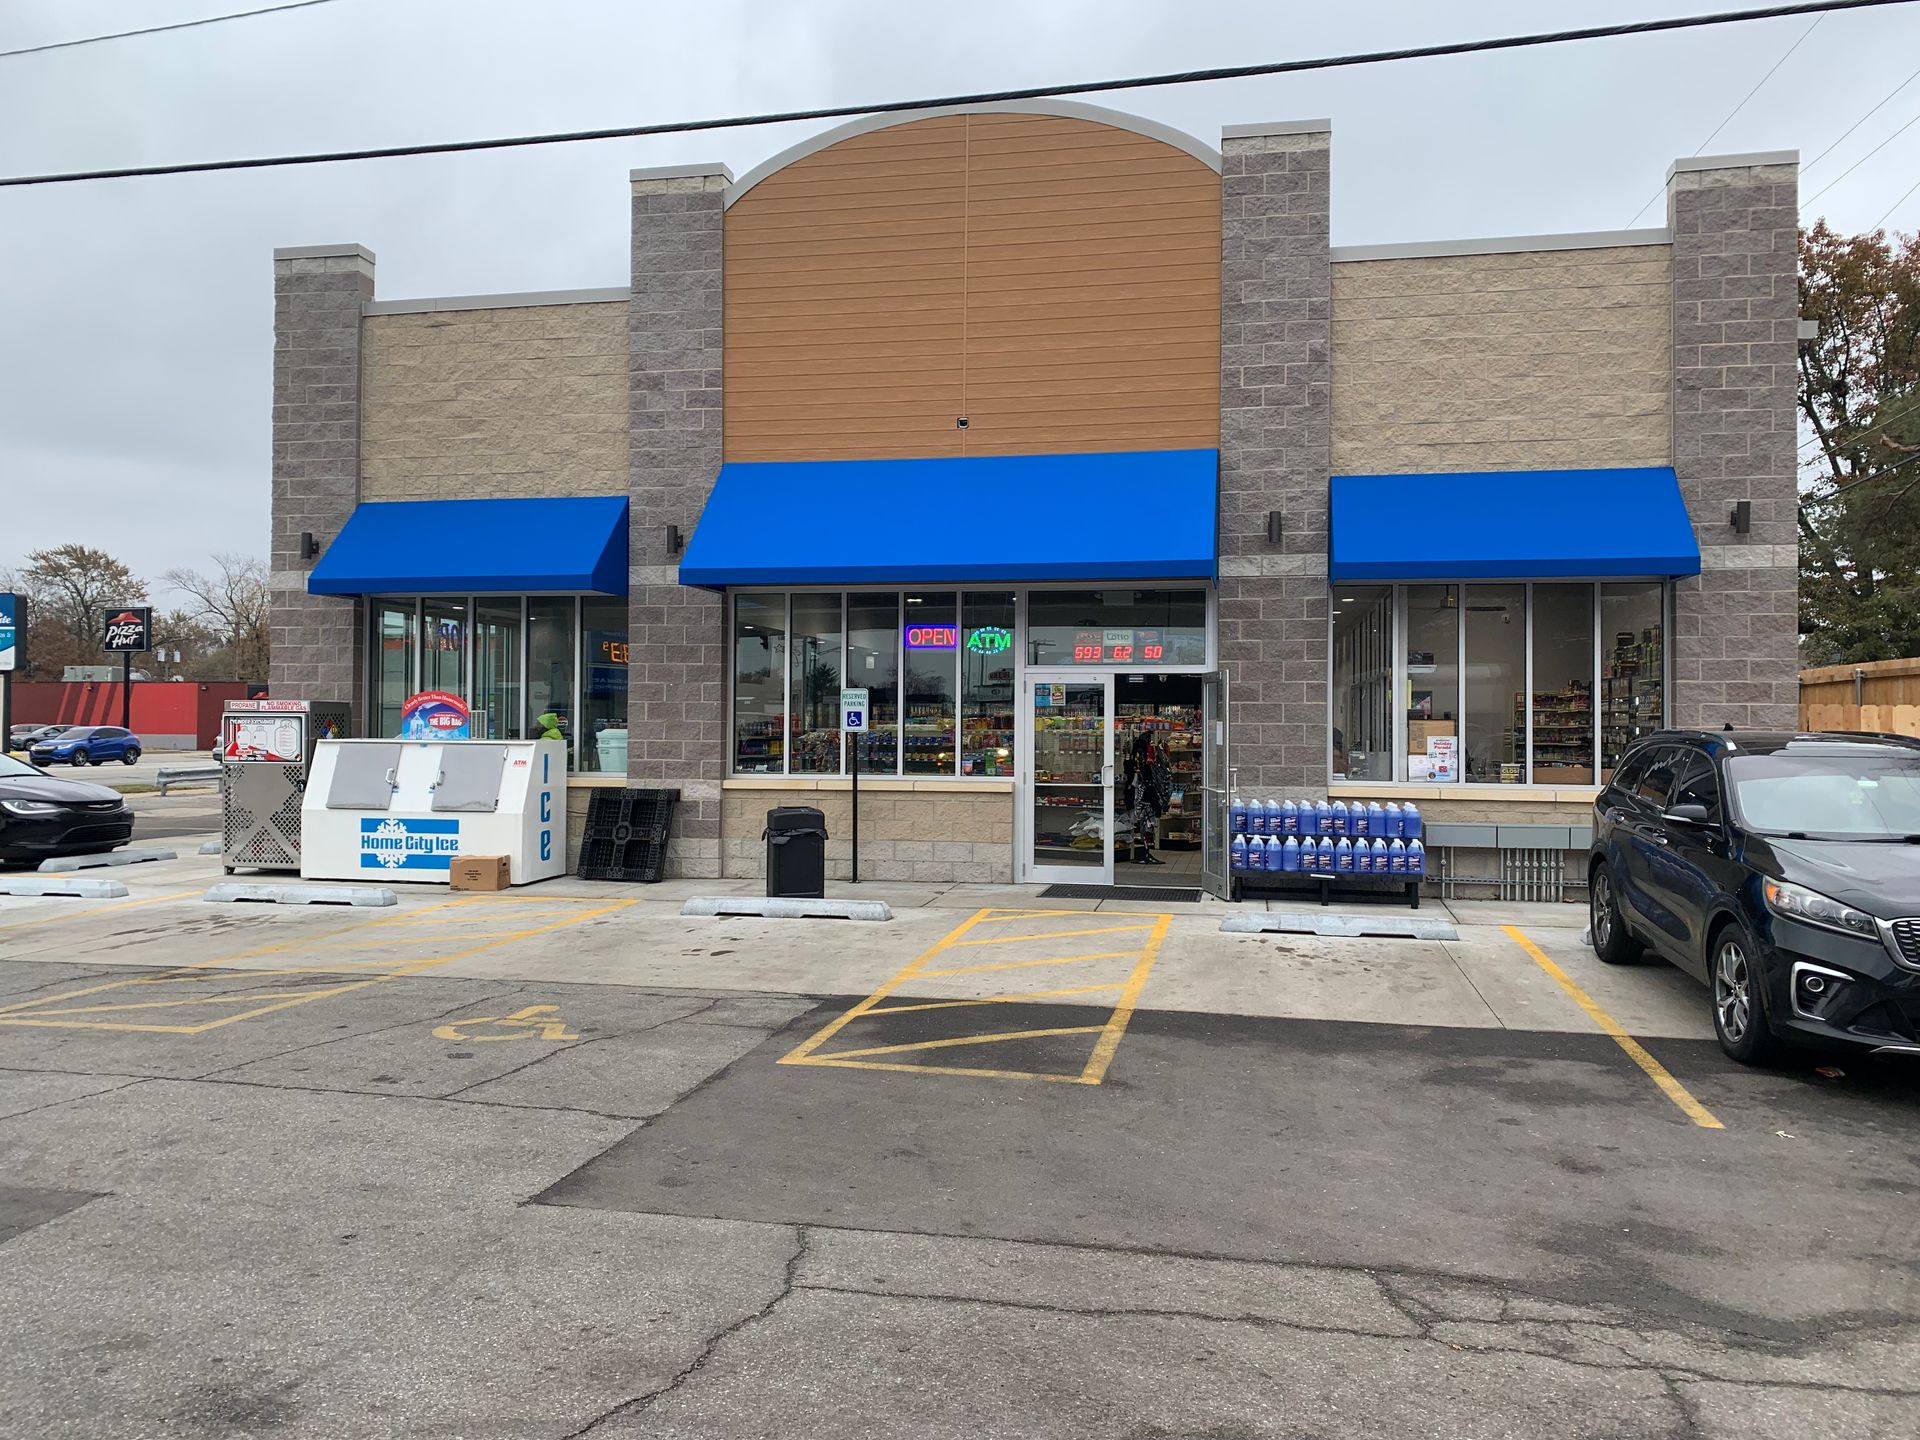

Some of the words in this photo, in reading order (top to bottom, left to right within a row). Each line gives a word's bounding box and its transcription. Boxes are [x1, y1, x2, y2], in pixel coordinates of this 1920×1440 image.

[106, 621, 144, 643] Pizza
[908, 628, 956, 646] OPEN
[1106, 633, 1130, 641] Lotto
[112, 634, 140, 648] Hut
[966, 633, 1011, 648] ATM
[1074, 646, 1102, 659] 593
[1144, 646, 1163, 659] 50
[429, 717, 439, 726] THE
[440, 716, 451, 726] BIG
[451, 717, 463, 727] BAG
[361, 834, 403, 850] Home
[405, 836, 433, 854] City
[435, 836, 459, 851] Ice
